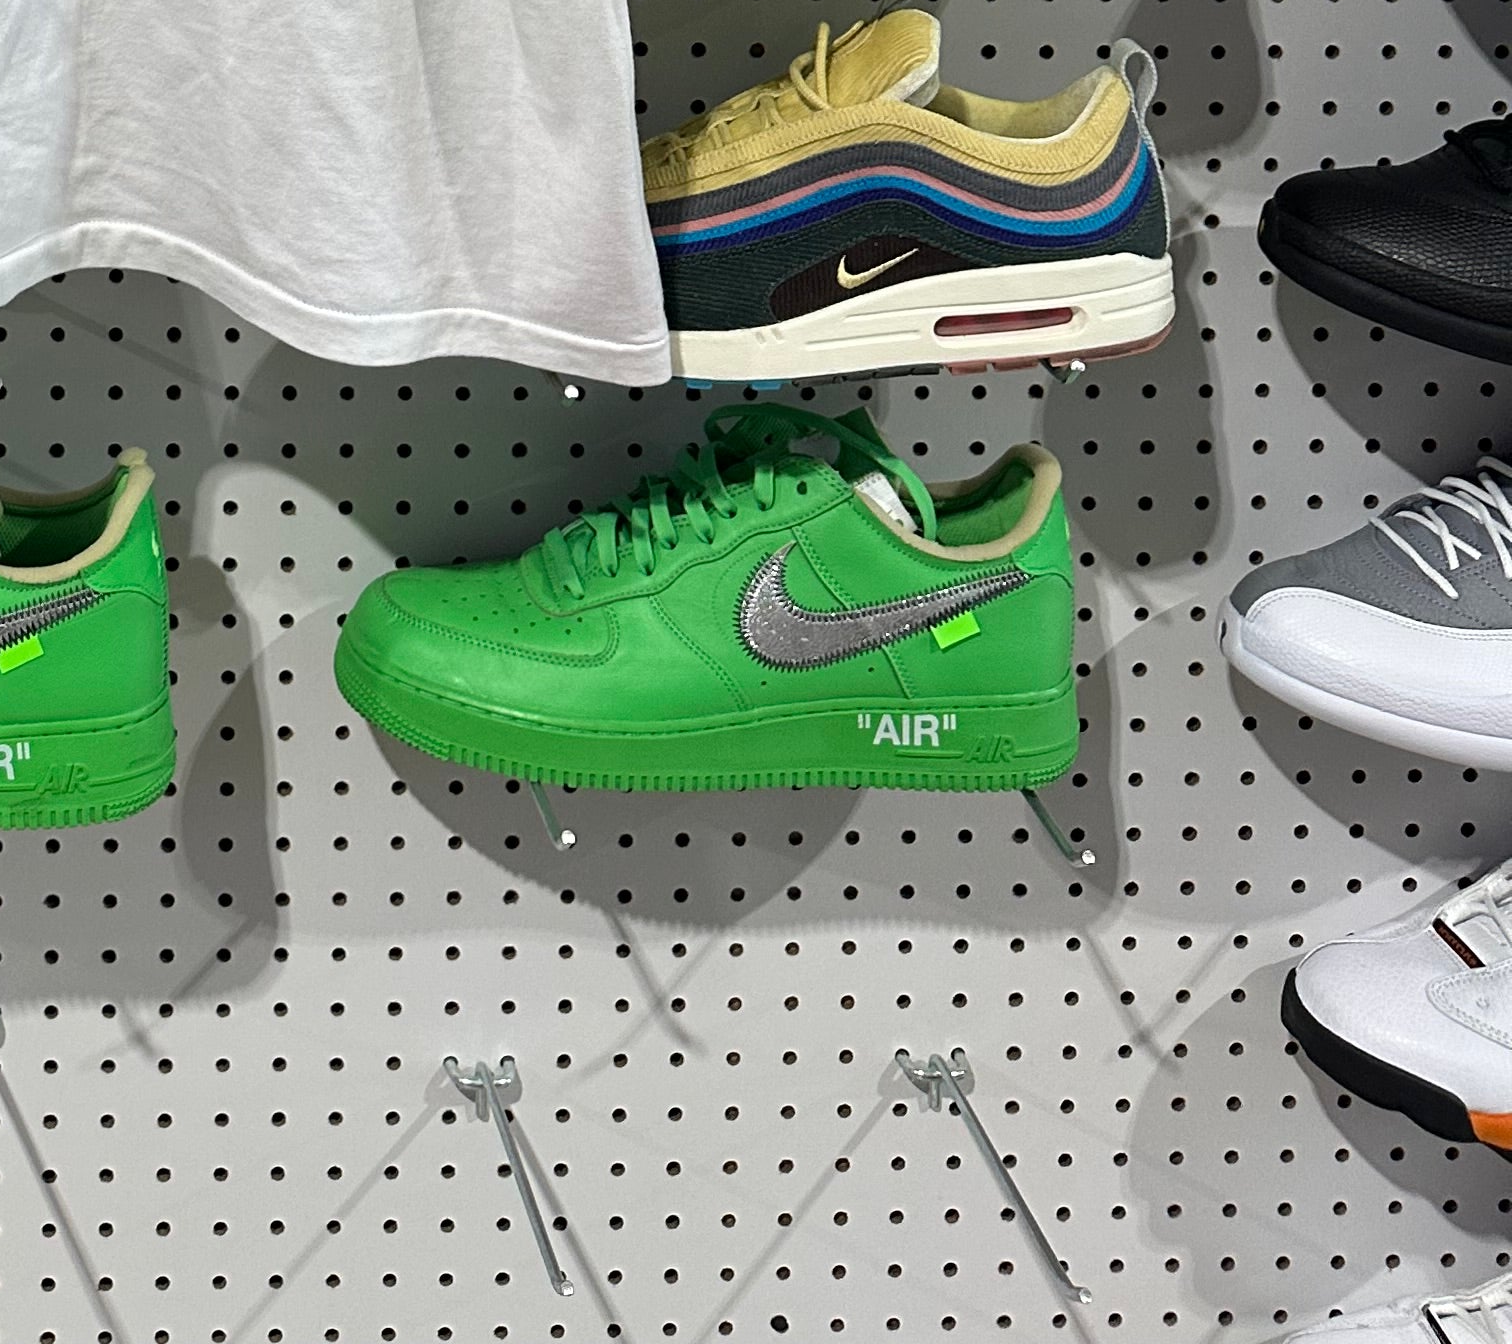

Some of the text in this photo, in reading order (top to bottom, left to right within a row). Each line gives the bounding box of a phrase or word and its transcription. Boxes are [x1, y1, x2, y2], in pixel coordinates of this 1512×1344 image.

[857, 713, 957, 747] "AIR"
[965, 735, 1016, 763] AIR
[38, 762, 90, 795] AIR
